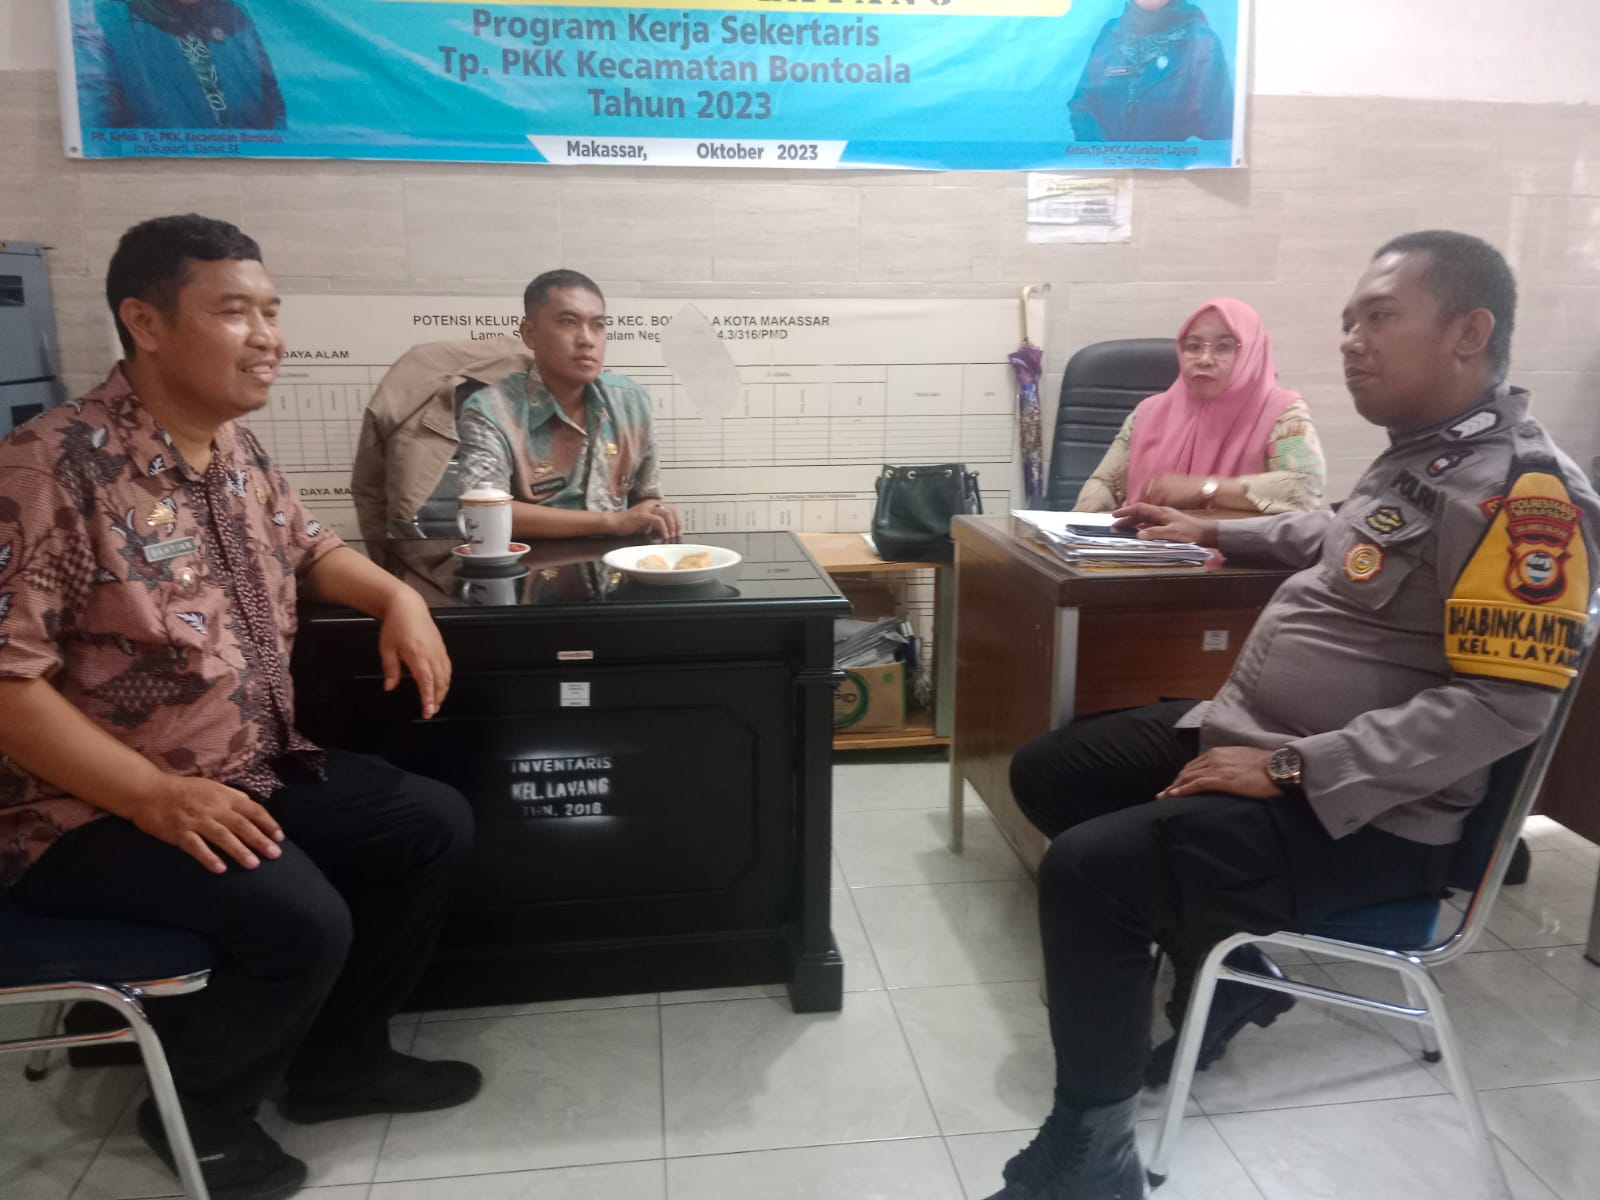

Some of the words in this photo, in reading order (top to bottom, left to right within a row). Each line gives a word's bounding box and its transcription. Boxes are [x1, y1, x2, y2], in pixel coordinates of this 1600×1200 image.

[473, 9, 616, 46] Program
[628, 12, 710, 50] Kerja
[721, 14, 880, 46] Sekertaris
[438, 46, 489, 82] Tp.
[502, 48, 567, 77] PKK
[577, 50, 758, 82] Kecamatan
[768, 55, 911, 83] Bontoala
[588, 87, 686, 119] Tahun
[697, 91, 772, 120] 2023
[566, 140, 648, 161] Makassar,
[696, 142, 765, 161] Oktober
[777, 144, 819, 161] 2023
[413, 315, 472, 326] POTENSI
[617, 316, 647, 327] KEC.
[724, 316, 757, 327] KOTA
[760, 316, 830, 327] MAKASSAR
[606, 331, 635, 341] alam
[638, 330, 661, 343] Neg
[716, 330, 788, 341] 4.3/316/PMD
[315, 350, 350, 359] ALAM
[299, 488, 331, 496] DAYA
[1458, 637, 1500, 657] KEL.
[511, 756, 613, 774] INVENTARIS
[565, 802, 602, 816] 2018
